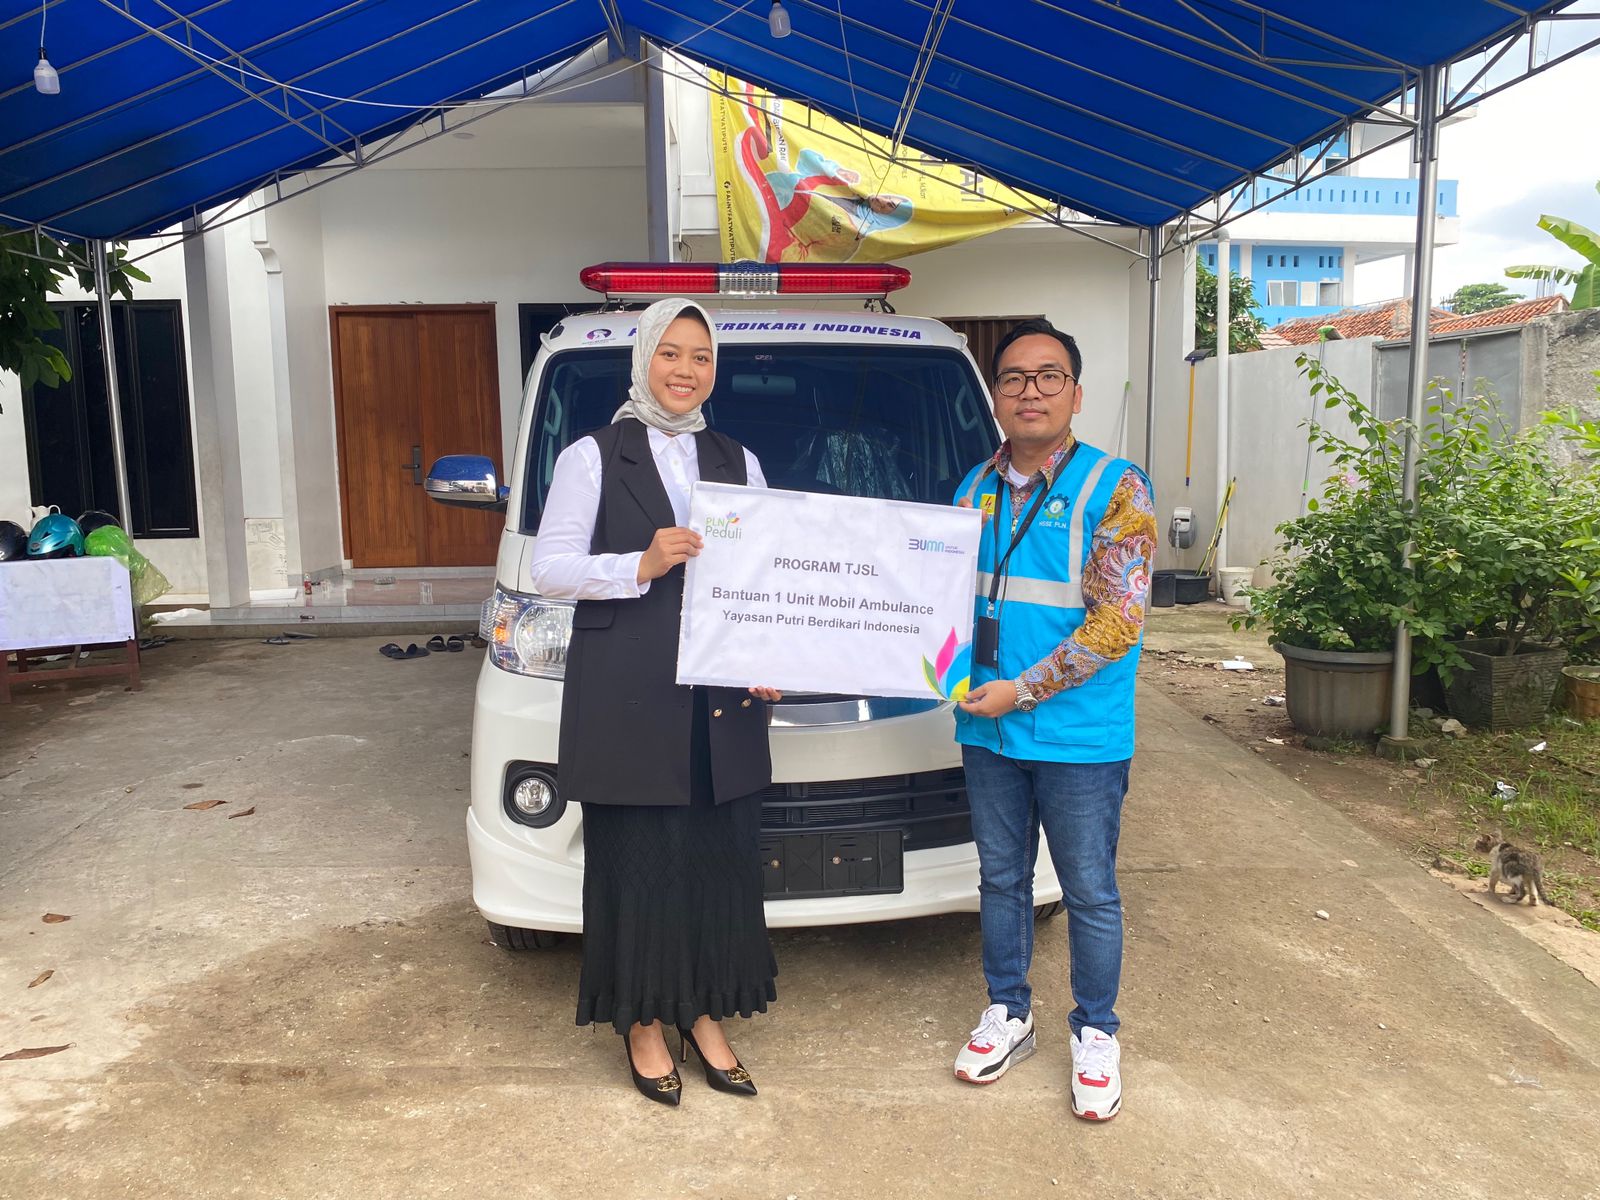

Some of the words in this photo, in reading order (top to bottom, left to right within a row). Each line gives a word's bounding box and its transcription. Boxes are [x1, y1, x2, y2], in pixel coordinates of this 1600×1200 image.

[714, 321, 806, 332] ERDIKARI
[813, 322, 922, 340] INDONESIA
[706, 517, 725, 528] PLN
[705, 525, 742, 540] Peduli
[774, 557, 841, 574] PROGRAM
[845, 562, 879, 576] TJSL
[712, 586, 770, 603] Bantuan
[775, 591, 782, 603] 1
[786, 592, 815, 606] Unit
[818, 594, 856, 609] Mobil
[858, 598, 934, 615] Ambulance
[722, 609, 773, 624] Yayasan
[776, 613, 805, 626] Putri
[808, 616, 861, 631] Berdikari
[864, 620, 920, 634] Indonesia
